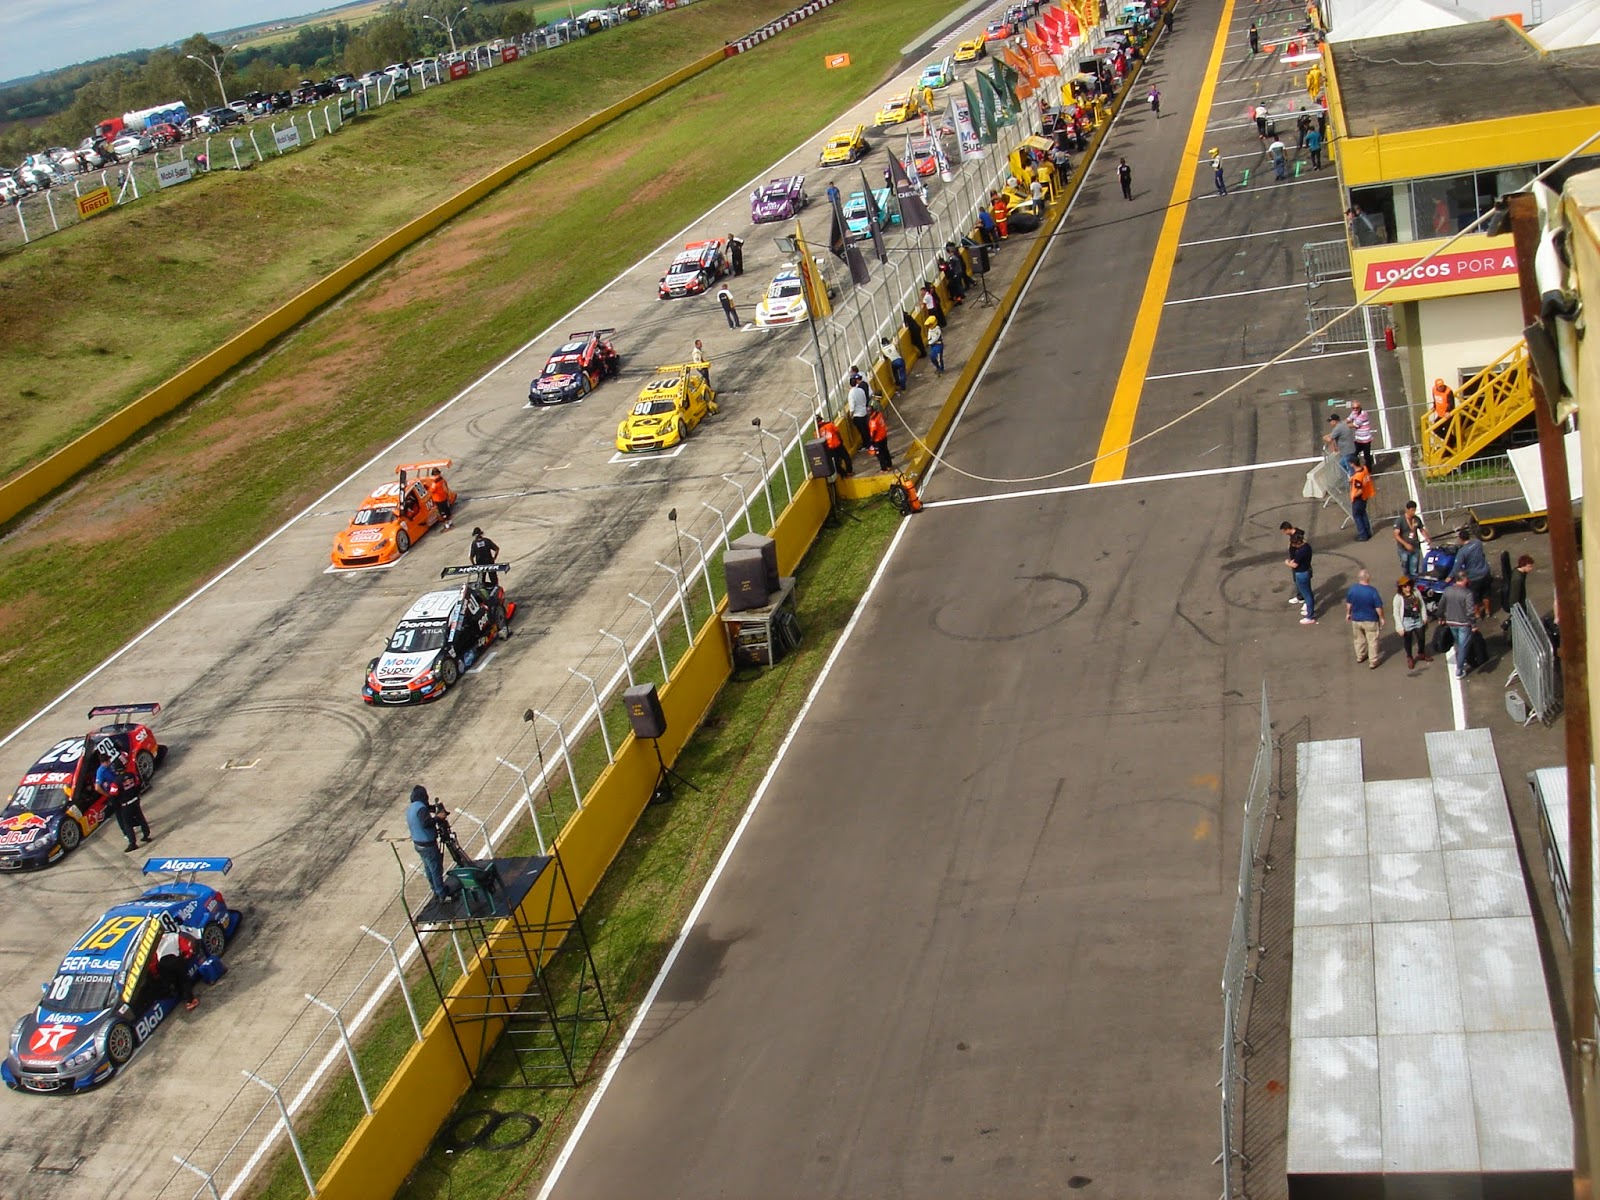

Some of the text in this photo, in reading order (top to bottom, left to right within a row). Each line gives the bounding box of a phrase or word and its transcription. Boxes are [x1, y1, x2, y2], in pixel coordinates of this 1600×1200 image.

[80, 191, 110, 214] PIRELLI
[1376, 263, 1450, 283] LOUCOS
[1457, 258, 1495, 274] POR
[634, 402, 652, 415] 90
[354, 510, 371, 524] 80
[397, 620, 447, 629] Pioneer
[391, 629, 415, 649] 51
[384, 657, 421, 667] Mobil
[379, 666, 416, 675] Super
[39, 740, 85, 764] 29
[11, 785, 35, 806] 29
[160, 860, 205, 872] Algar
[79, 916, 145, 950] 18
[75, 975, 113, 984] KHODAIR
[49, 975, 73, 1000] 18
[44, 1013, 79, 1024] Algar
